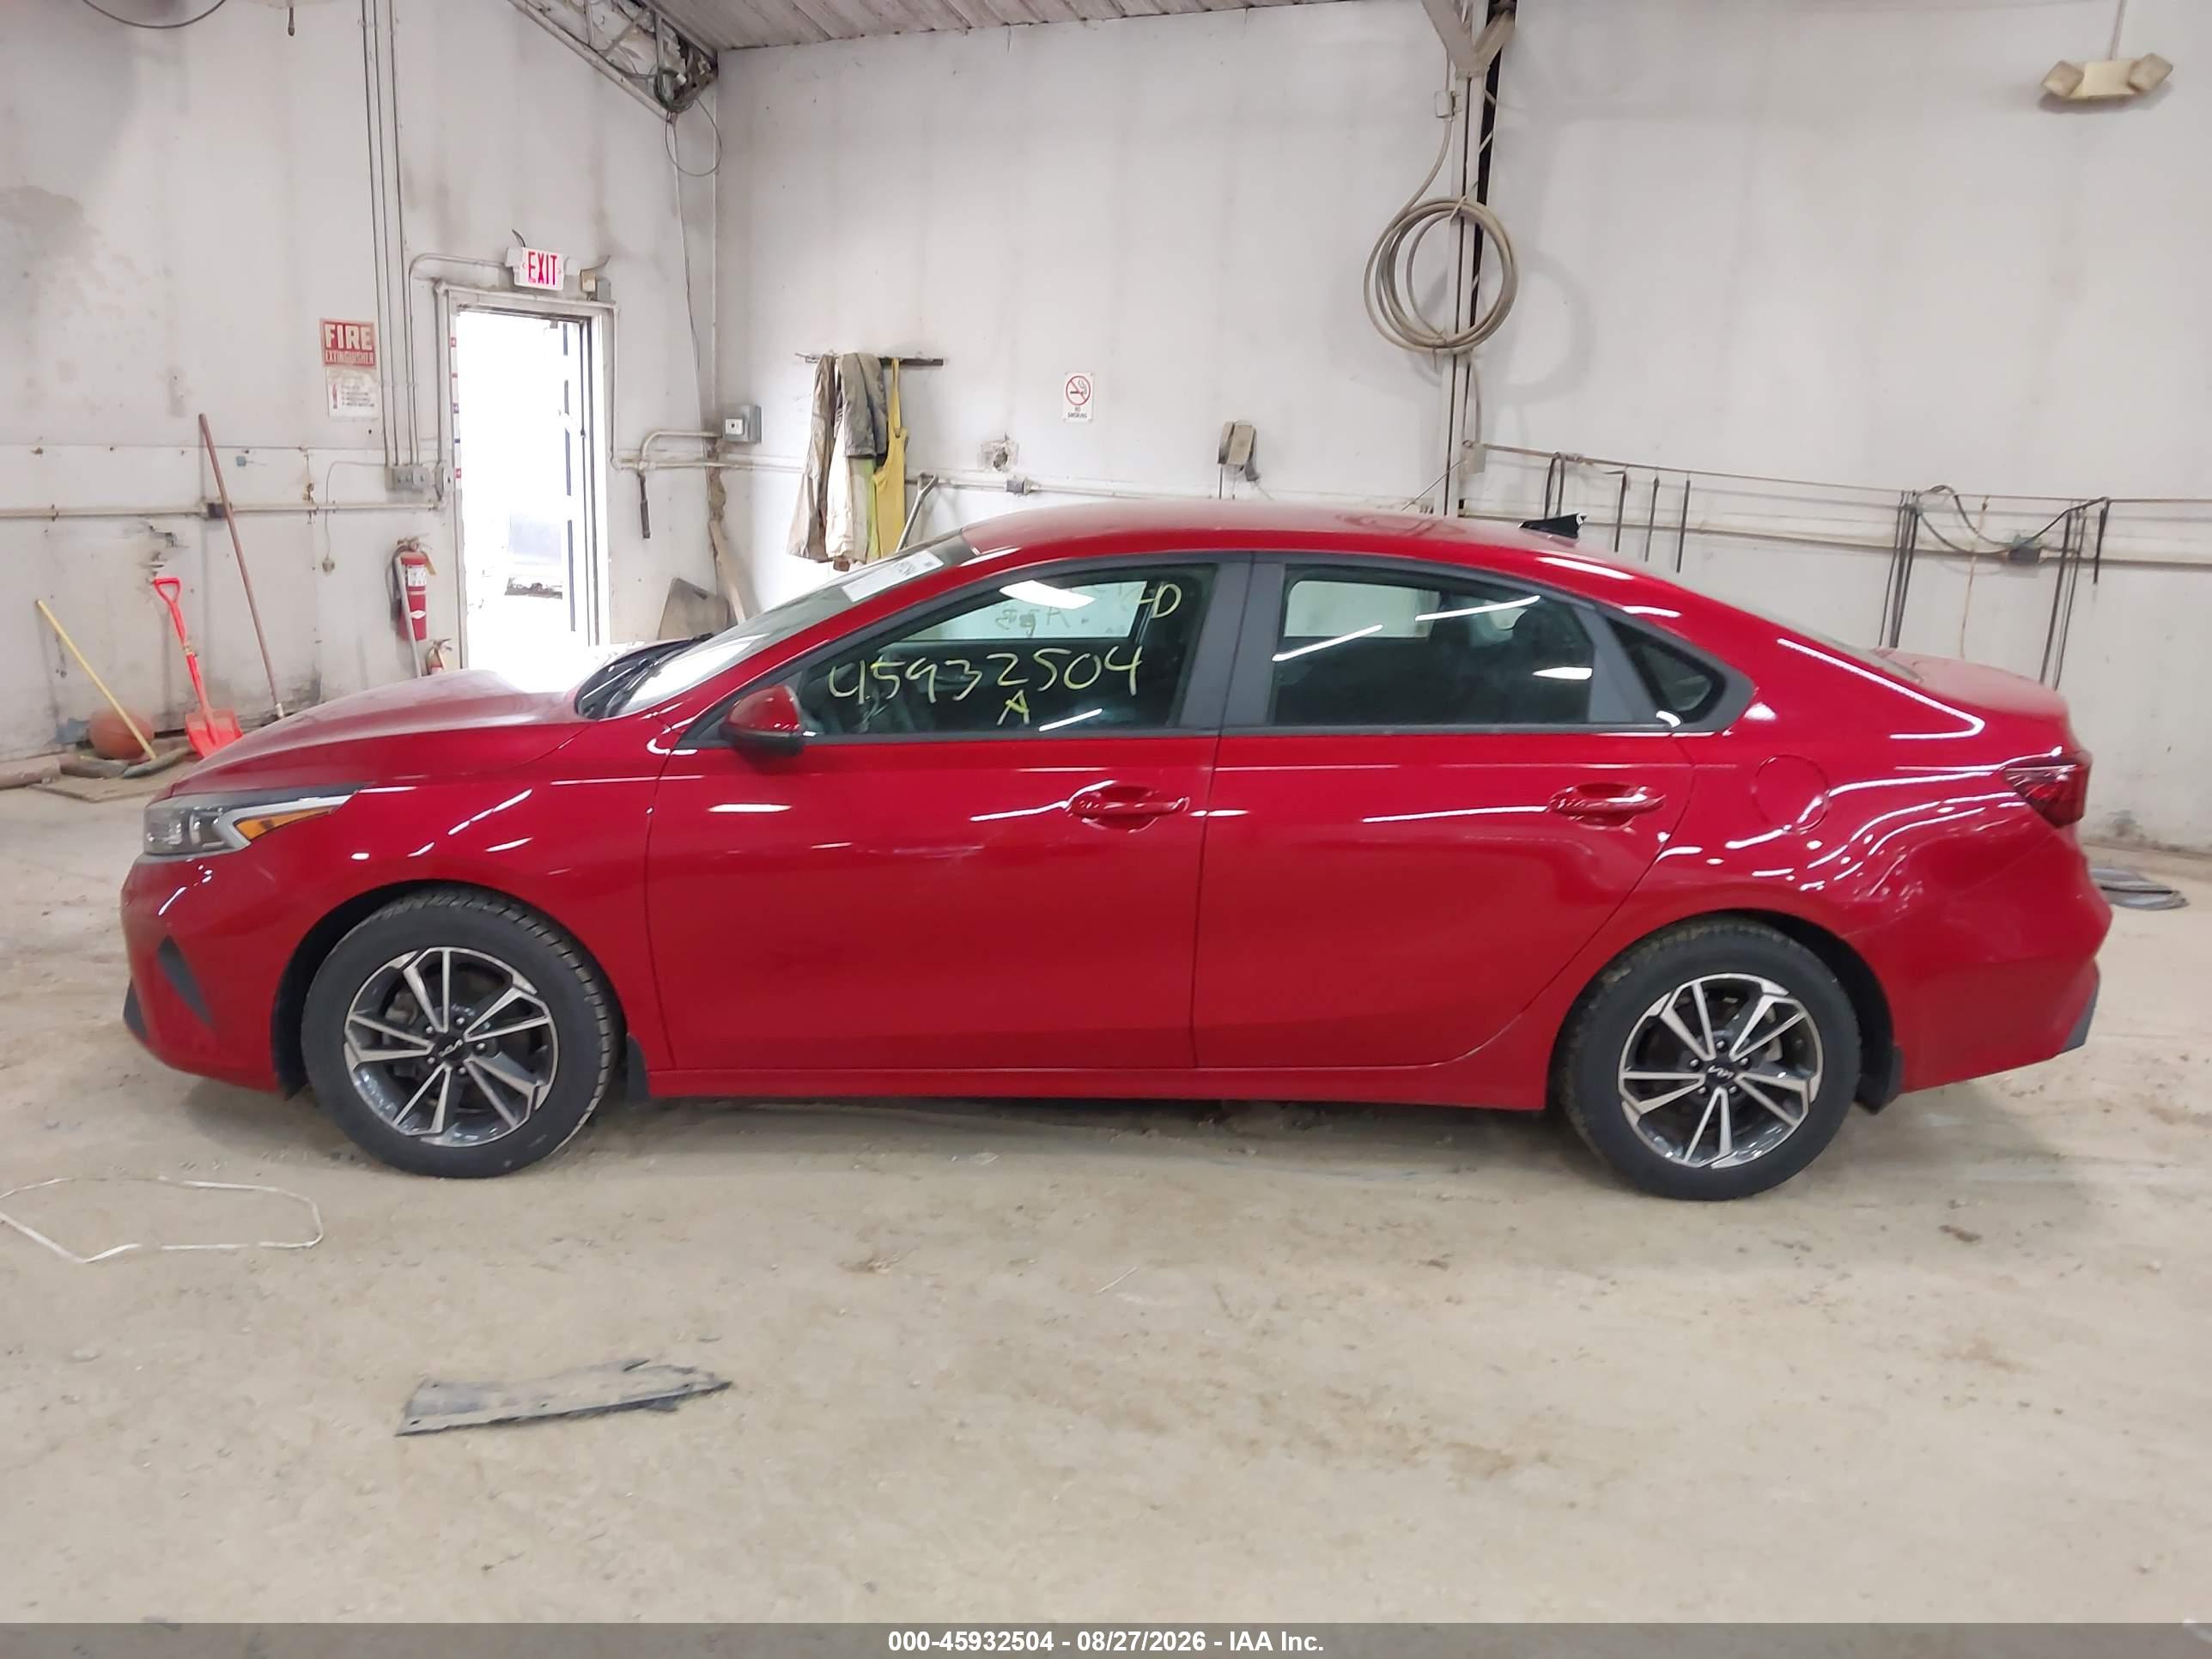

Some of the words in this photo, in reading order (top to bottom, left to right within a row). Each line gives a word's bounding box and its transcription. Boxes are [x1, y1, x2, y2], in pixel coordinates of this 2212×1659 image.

[528, 251, 557, 286] EXIT
[324, 323, 374, 351] FIRE
[828, 645, 1145, 704] 45932504
[996, 689, 1030, 726] A
